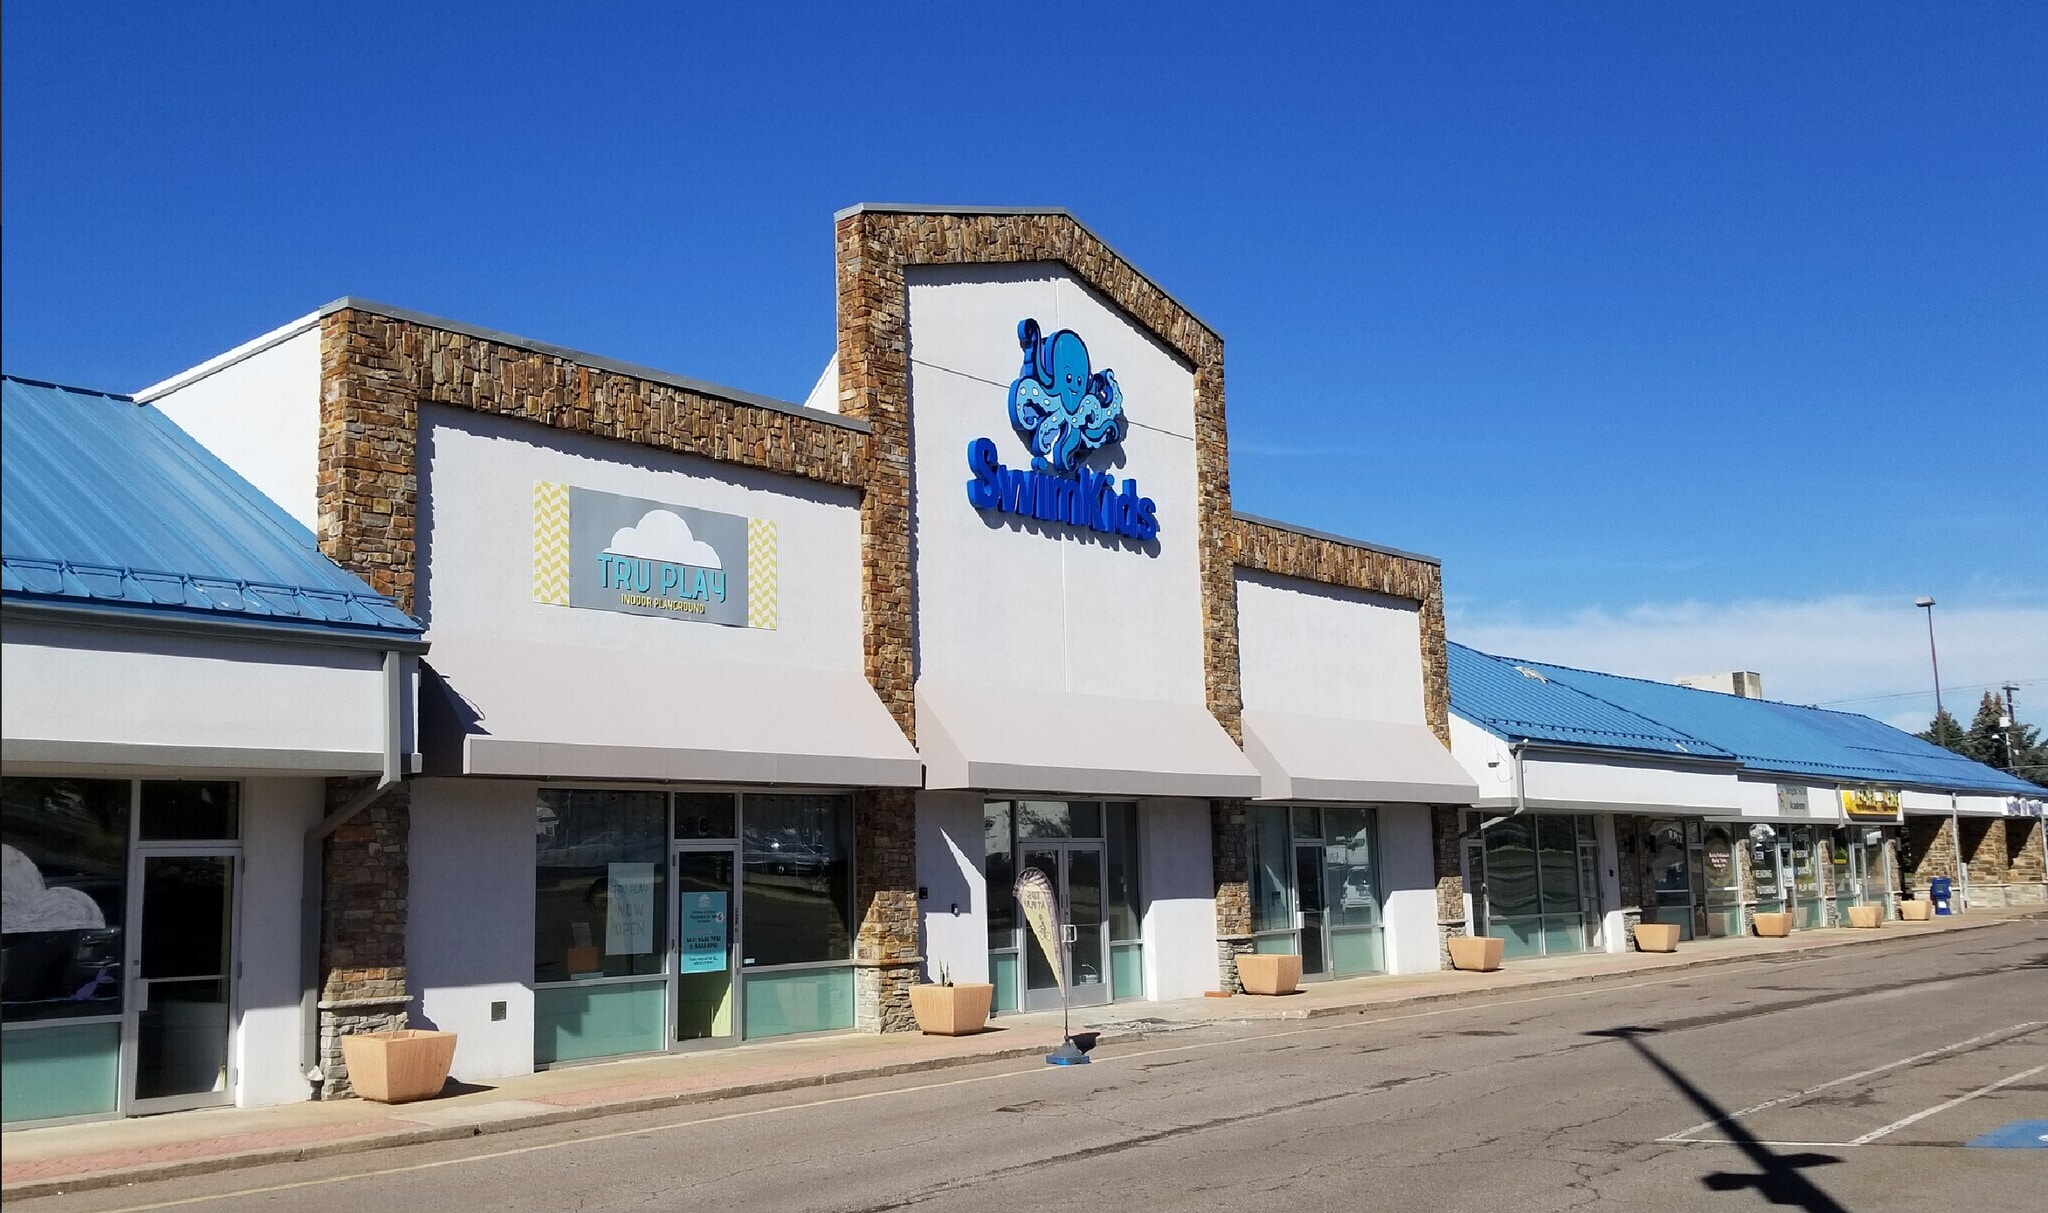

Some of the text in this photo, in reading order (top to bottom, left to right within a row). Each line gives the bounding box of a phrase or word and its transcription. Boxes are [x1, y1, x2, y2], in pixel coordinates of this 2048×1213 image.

[967, 437, 1157, 541] SwimKids
[596, 553, 727, 603] TRU PLAY
[621, 593, 706, 614] INDOOR PLAYGROUND
[614, 884, 648, 895] TRU PLAY
[617, 903, 645, 918] NOW
[615, 922, 645, 937] OPEN
